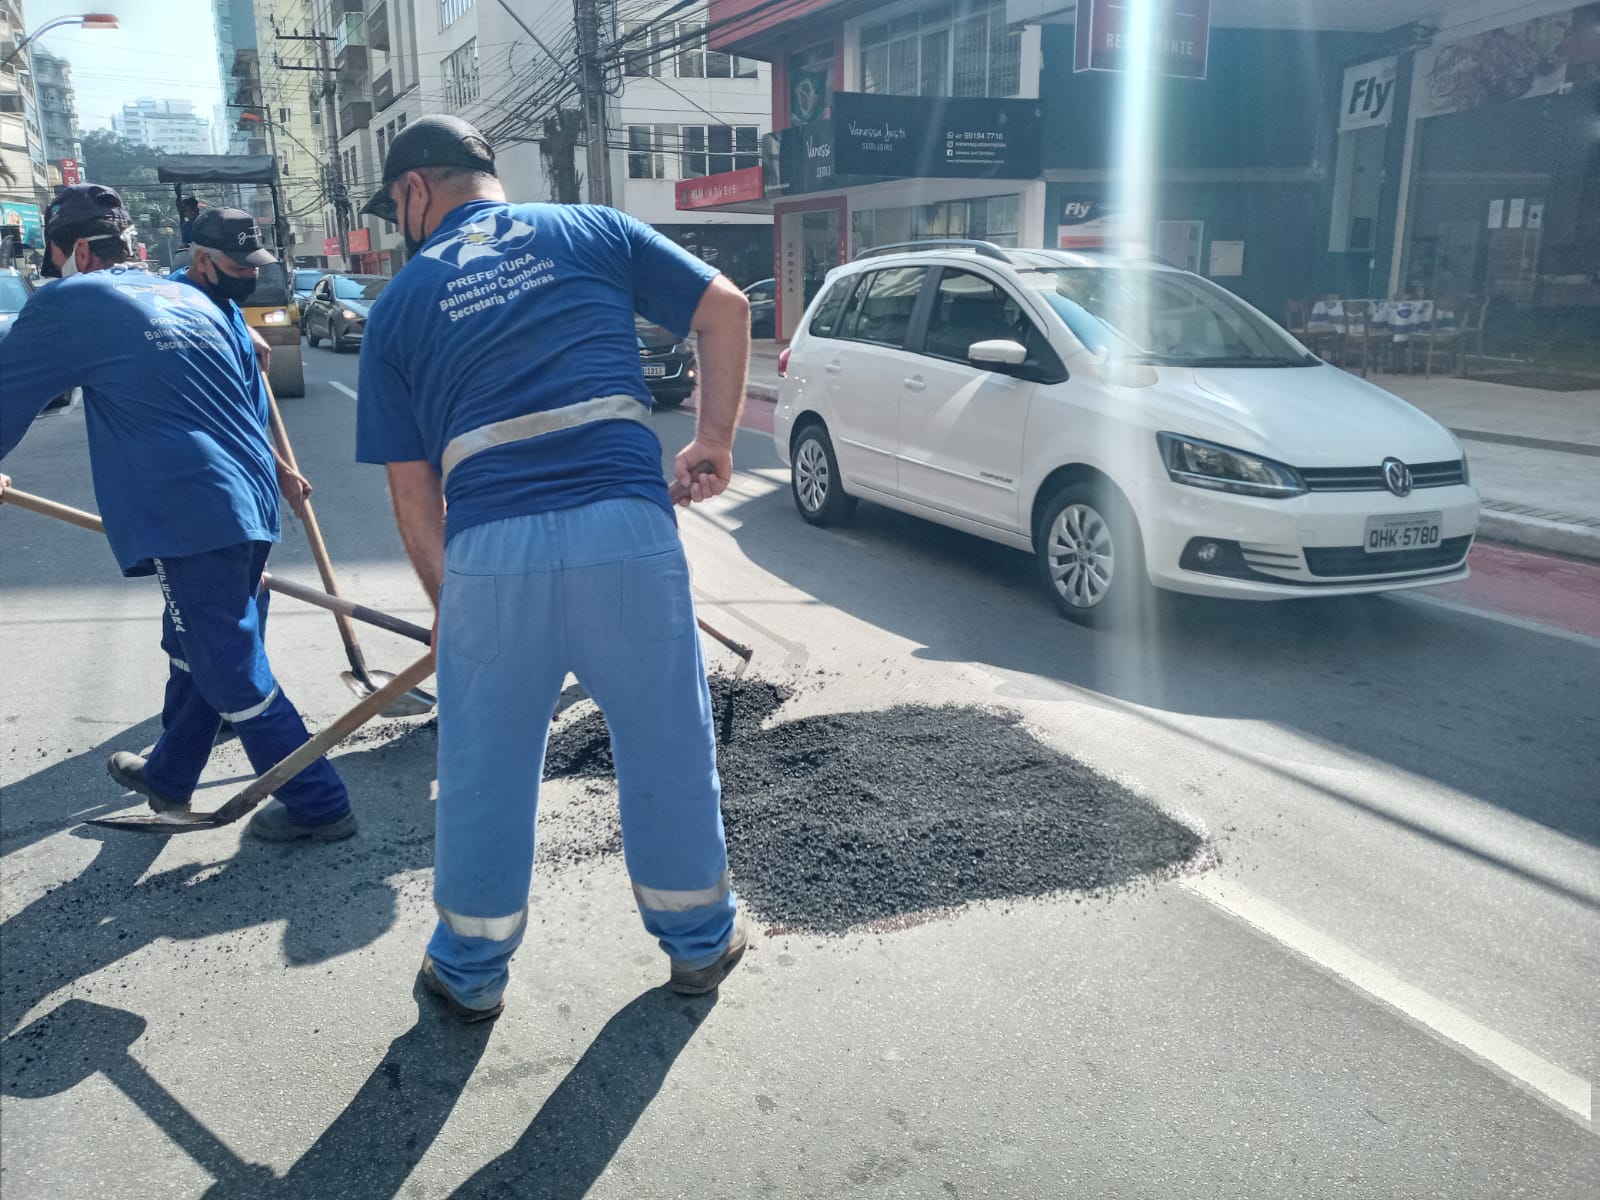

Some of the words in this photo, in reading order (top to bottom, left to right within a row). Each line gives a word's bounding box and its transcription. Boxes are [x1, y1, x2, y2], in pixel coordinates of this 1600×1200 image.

[1348, 76, 1393, 119] Fly
[848, 120, 882, 138] Vanessa
[1065, 202, 1091, 218] Fly
[439, 279, 497, 312] Balneário
[499, 257, 555, 290] Camboriú
[446, 252, 535, 292] PREFEITURA
[449, 294, 506, 322] Secretaria
[507, 289, 520, 300] de
[521, 273, 554, 291] Obras
[153, 557, 187, 632] REFEITURA
